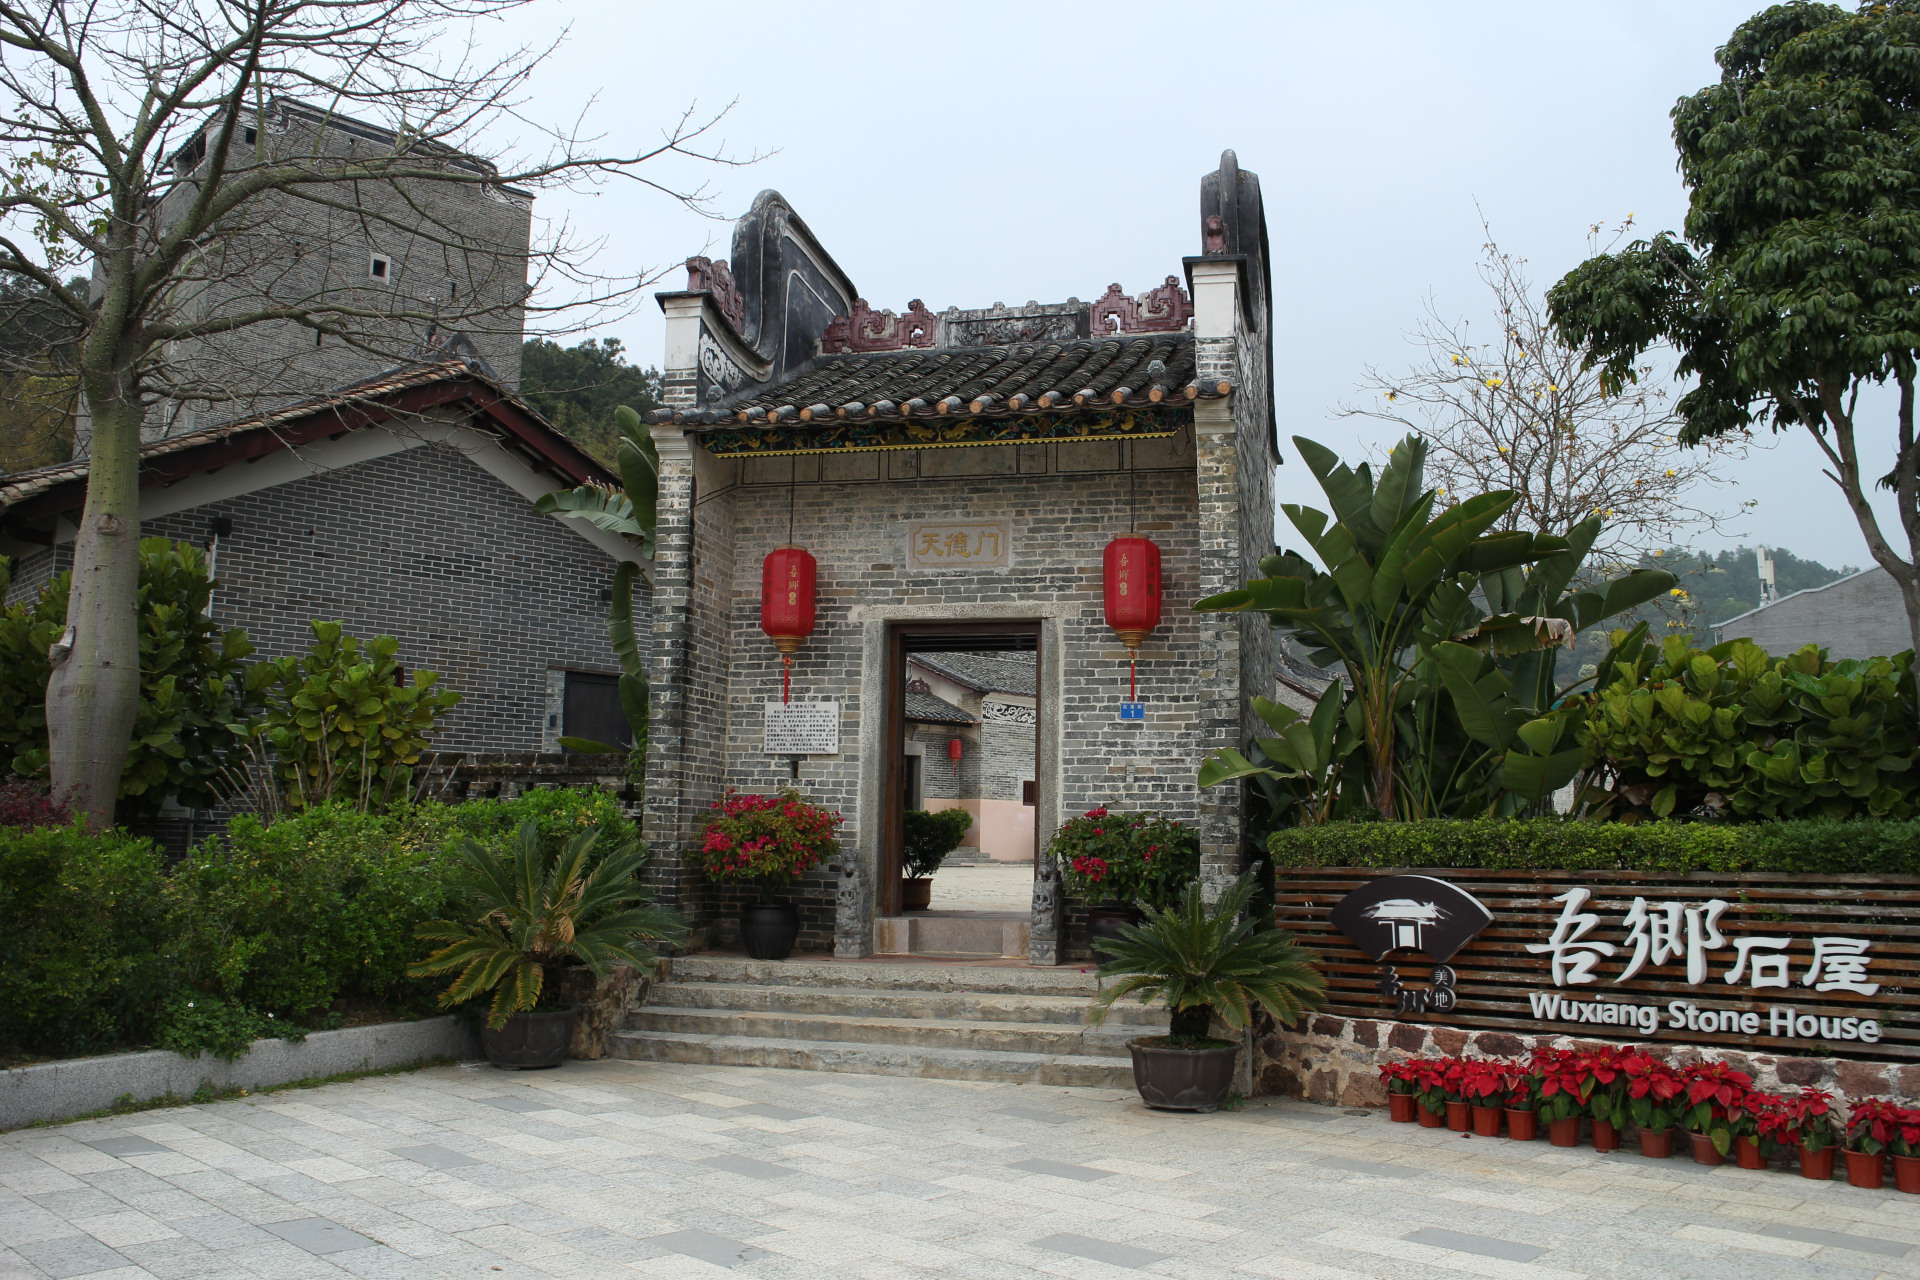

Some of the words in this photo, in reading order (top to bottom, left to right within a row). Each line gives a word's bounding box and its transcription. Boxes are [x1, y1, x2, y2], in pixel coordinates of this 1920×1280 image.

[917, 531, 999, 558] 天德门
[1130, 710, 1135, 718] 1
[1434, 969, 1449, 1008] 美地
[1528, 992, 1659, 1035] Wuxiang
[1668, 1000, 1761, 1035] Stone
[1769, 1007, 1880, 1043] House
